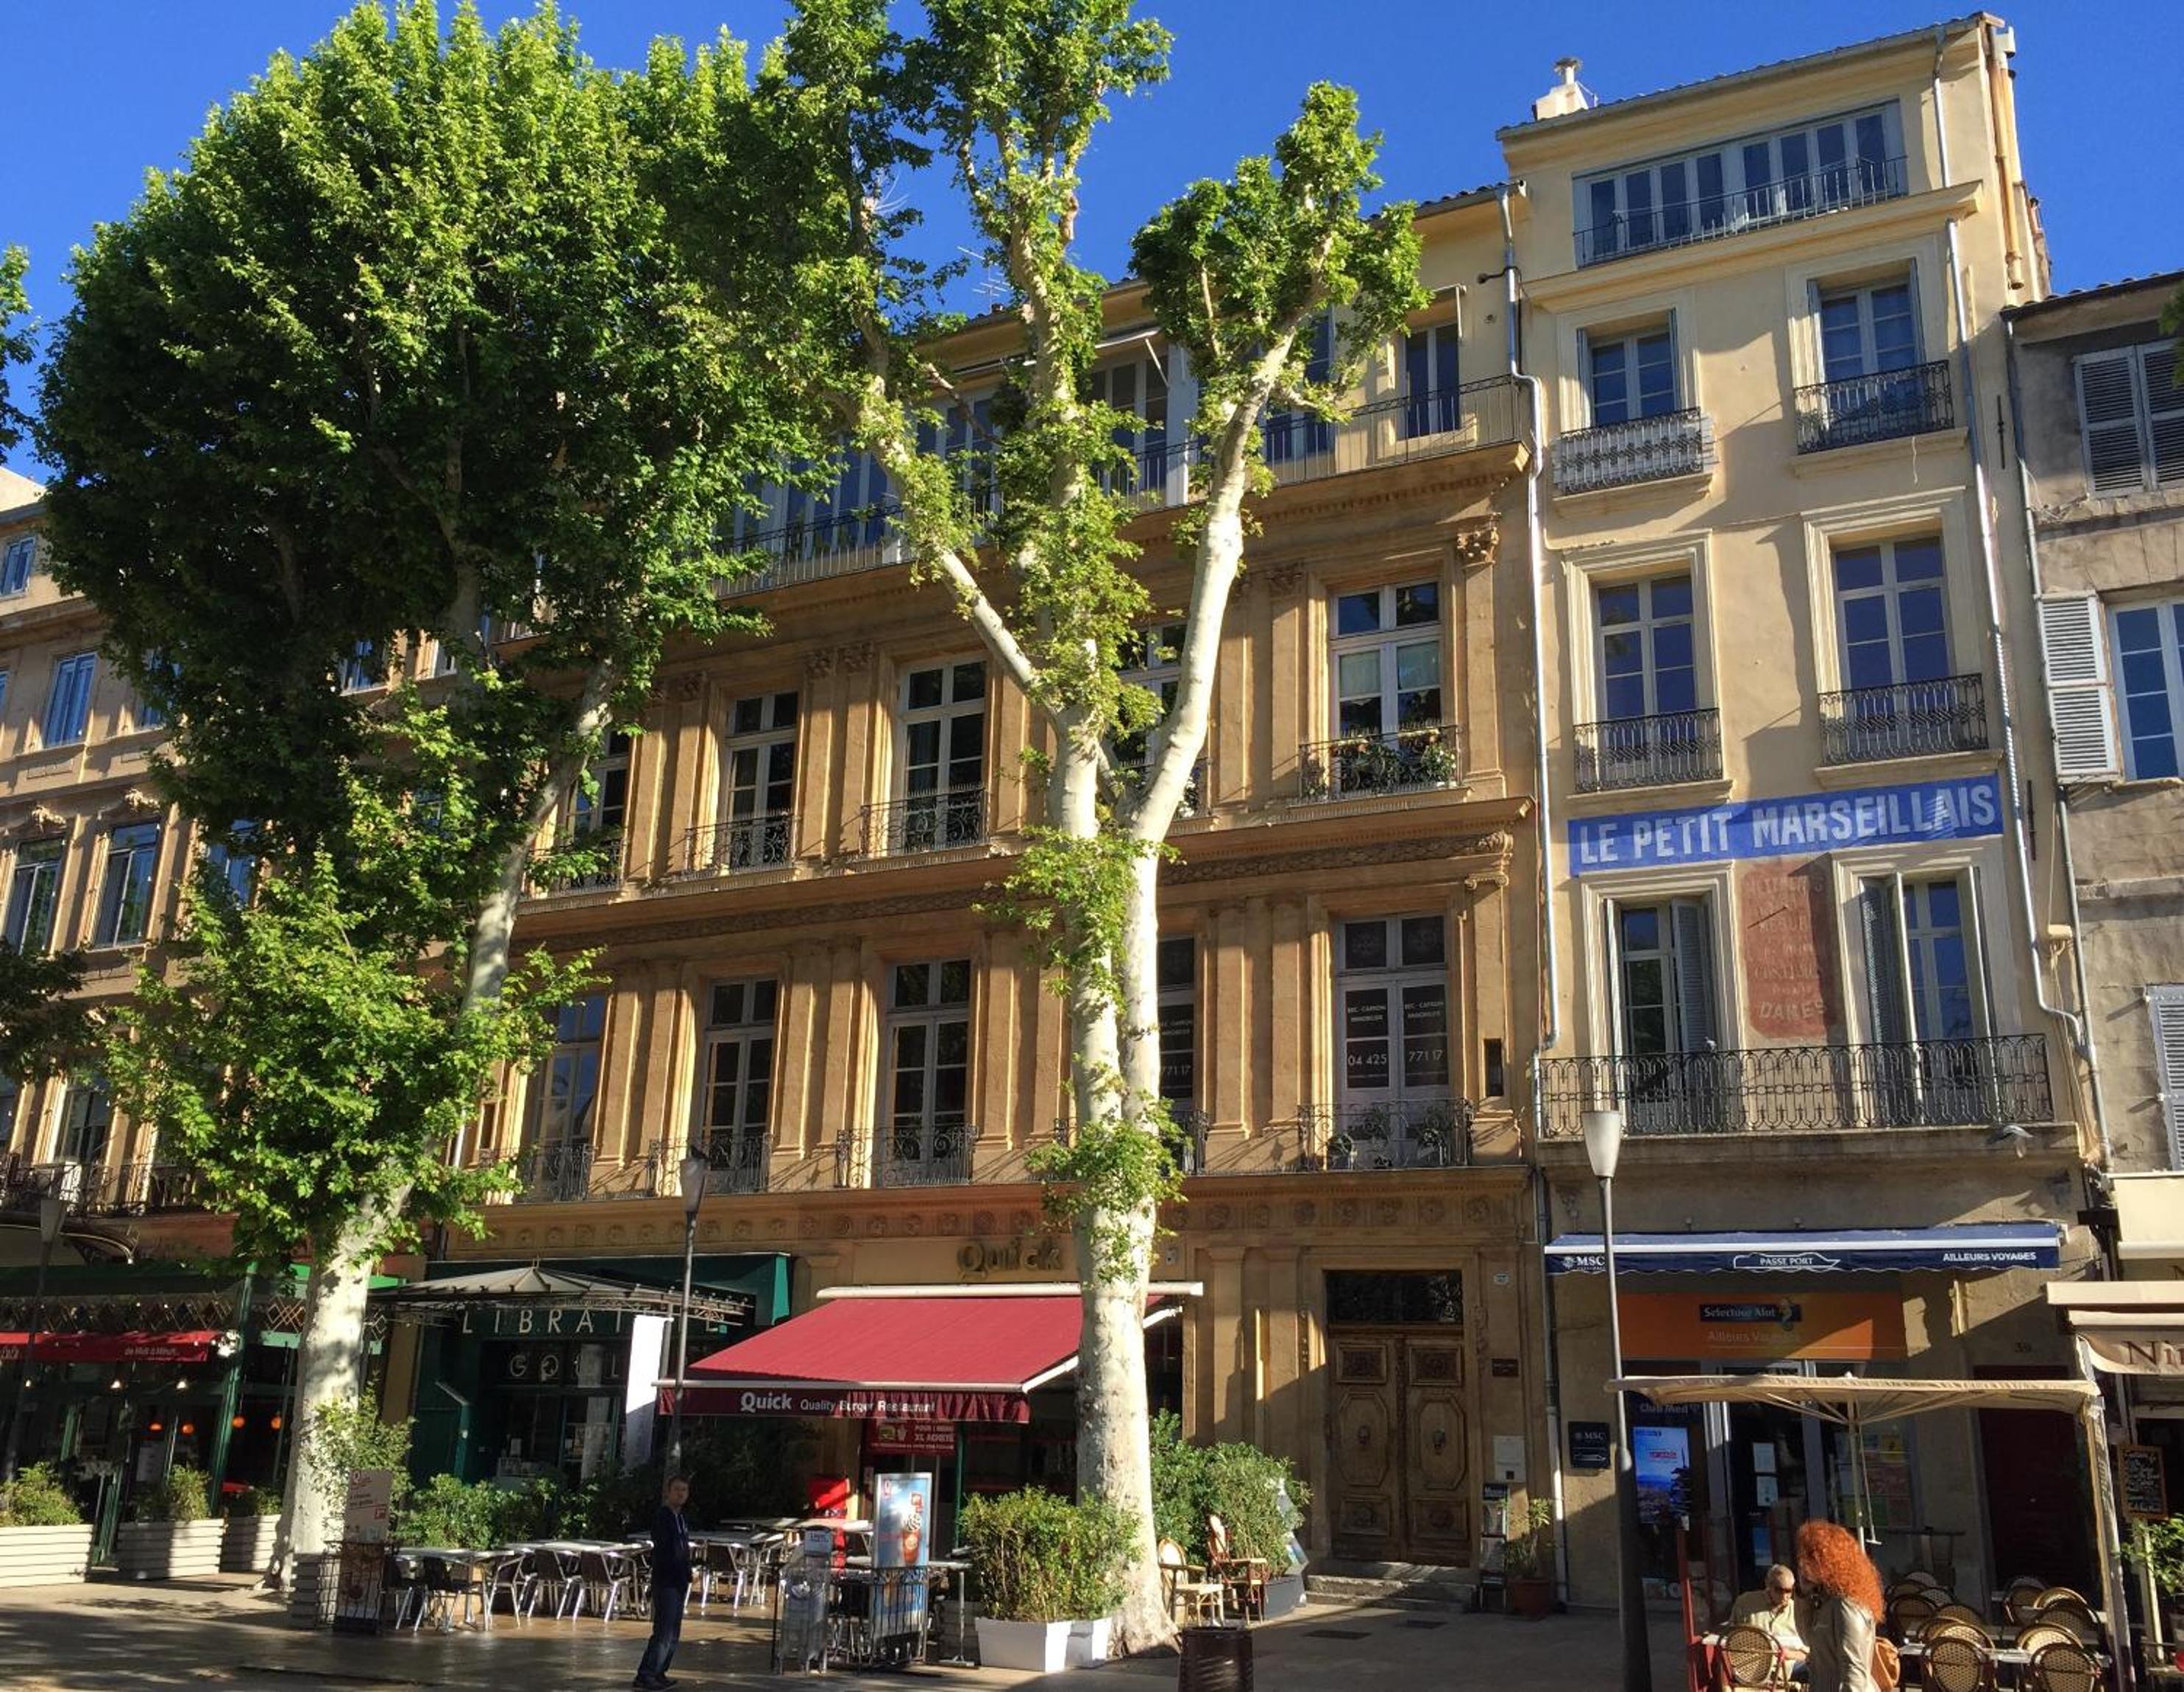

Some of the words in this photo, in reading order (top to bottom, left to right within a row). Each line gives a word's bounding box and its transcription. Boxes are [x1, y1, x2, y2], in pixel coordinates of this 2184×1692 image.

[1580, 823, 1619, 865] LE
[1632, 810, 1732, 859] PETIT
[1752, 784, 1993, 849] MARSEILLAIS
[958, 1238, 1060, 1279] Quick
[1576, 1255, 1606, 1267] MSC
[1790, 1257, 1814, 1265] PORT
[1943, 1252, 1990, 1261] AILLEURS
[1991, 1251, 2037, 1261] VOYAGES
[740, 1391, 793, 1413] Quick
[801, 1398, 837, 1413] Quality
[839, 1400, 873, 1413] Burger
[1584, 1431, 1604, 1440] MSC
